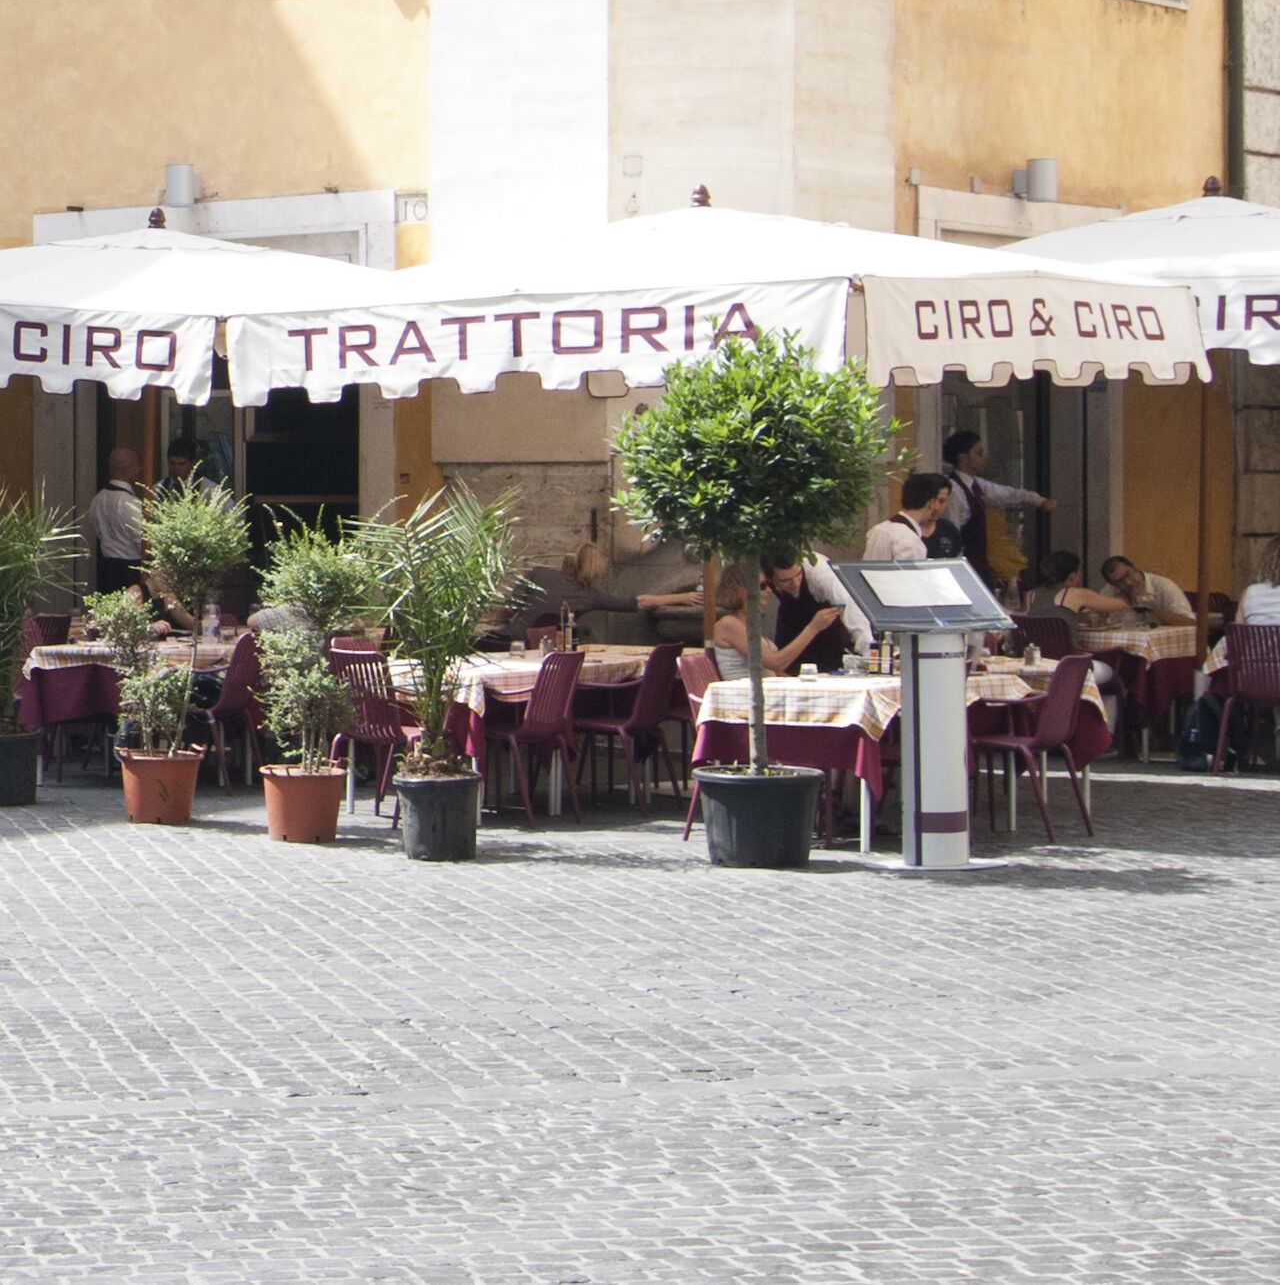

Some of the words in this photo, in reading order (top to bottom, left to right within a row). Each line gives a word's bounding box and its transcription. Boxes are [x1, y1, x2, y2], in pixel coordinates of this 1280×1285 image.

[287, 302, 759, 372] TRATTORIA
[914, 299, 1014, 340] CIRO
[1029, 297, 1056, 337] &
[1073, 300, 1165, 341] CIRO
[1195, 294, 1280, 332] IR
[13, 320, 177, 372] CIRO
